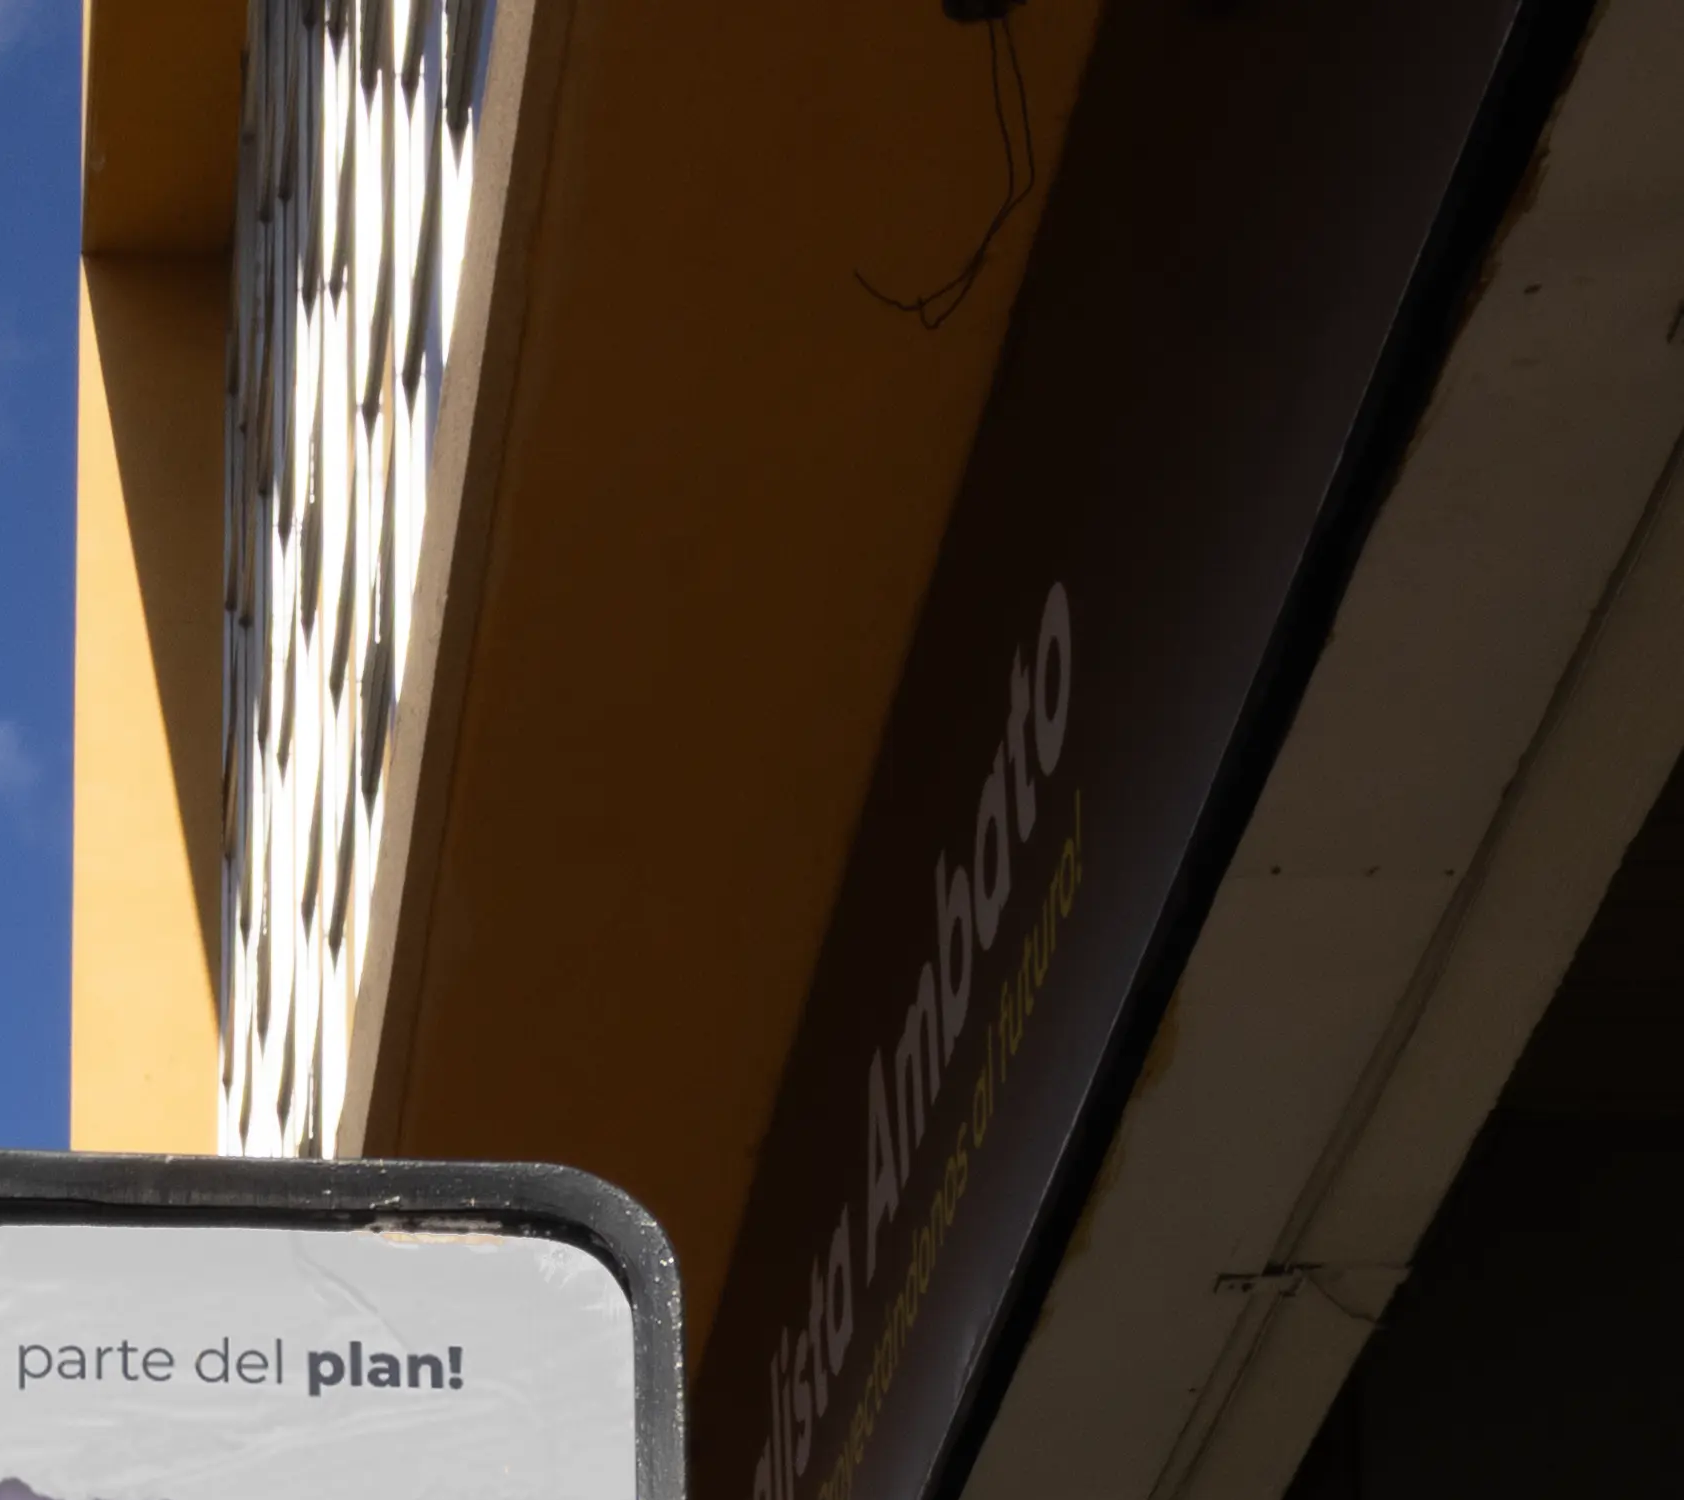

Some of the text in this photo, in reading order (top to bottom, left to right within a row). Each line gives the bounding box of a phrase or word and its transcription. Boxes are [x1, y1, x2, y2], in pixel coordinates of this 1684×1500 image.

[867, 582, 1071, 1288] Ambato
[973, 1026, 993, 1148] al
[19, 1340, 175, 1389] parte
[195, 1336, 283, 1384] del
[308, 1341, 464, 1396] plan!
